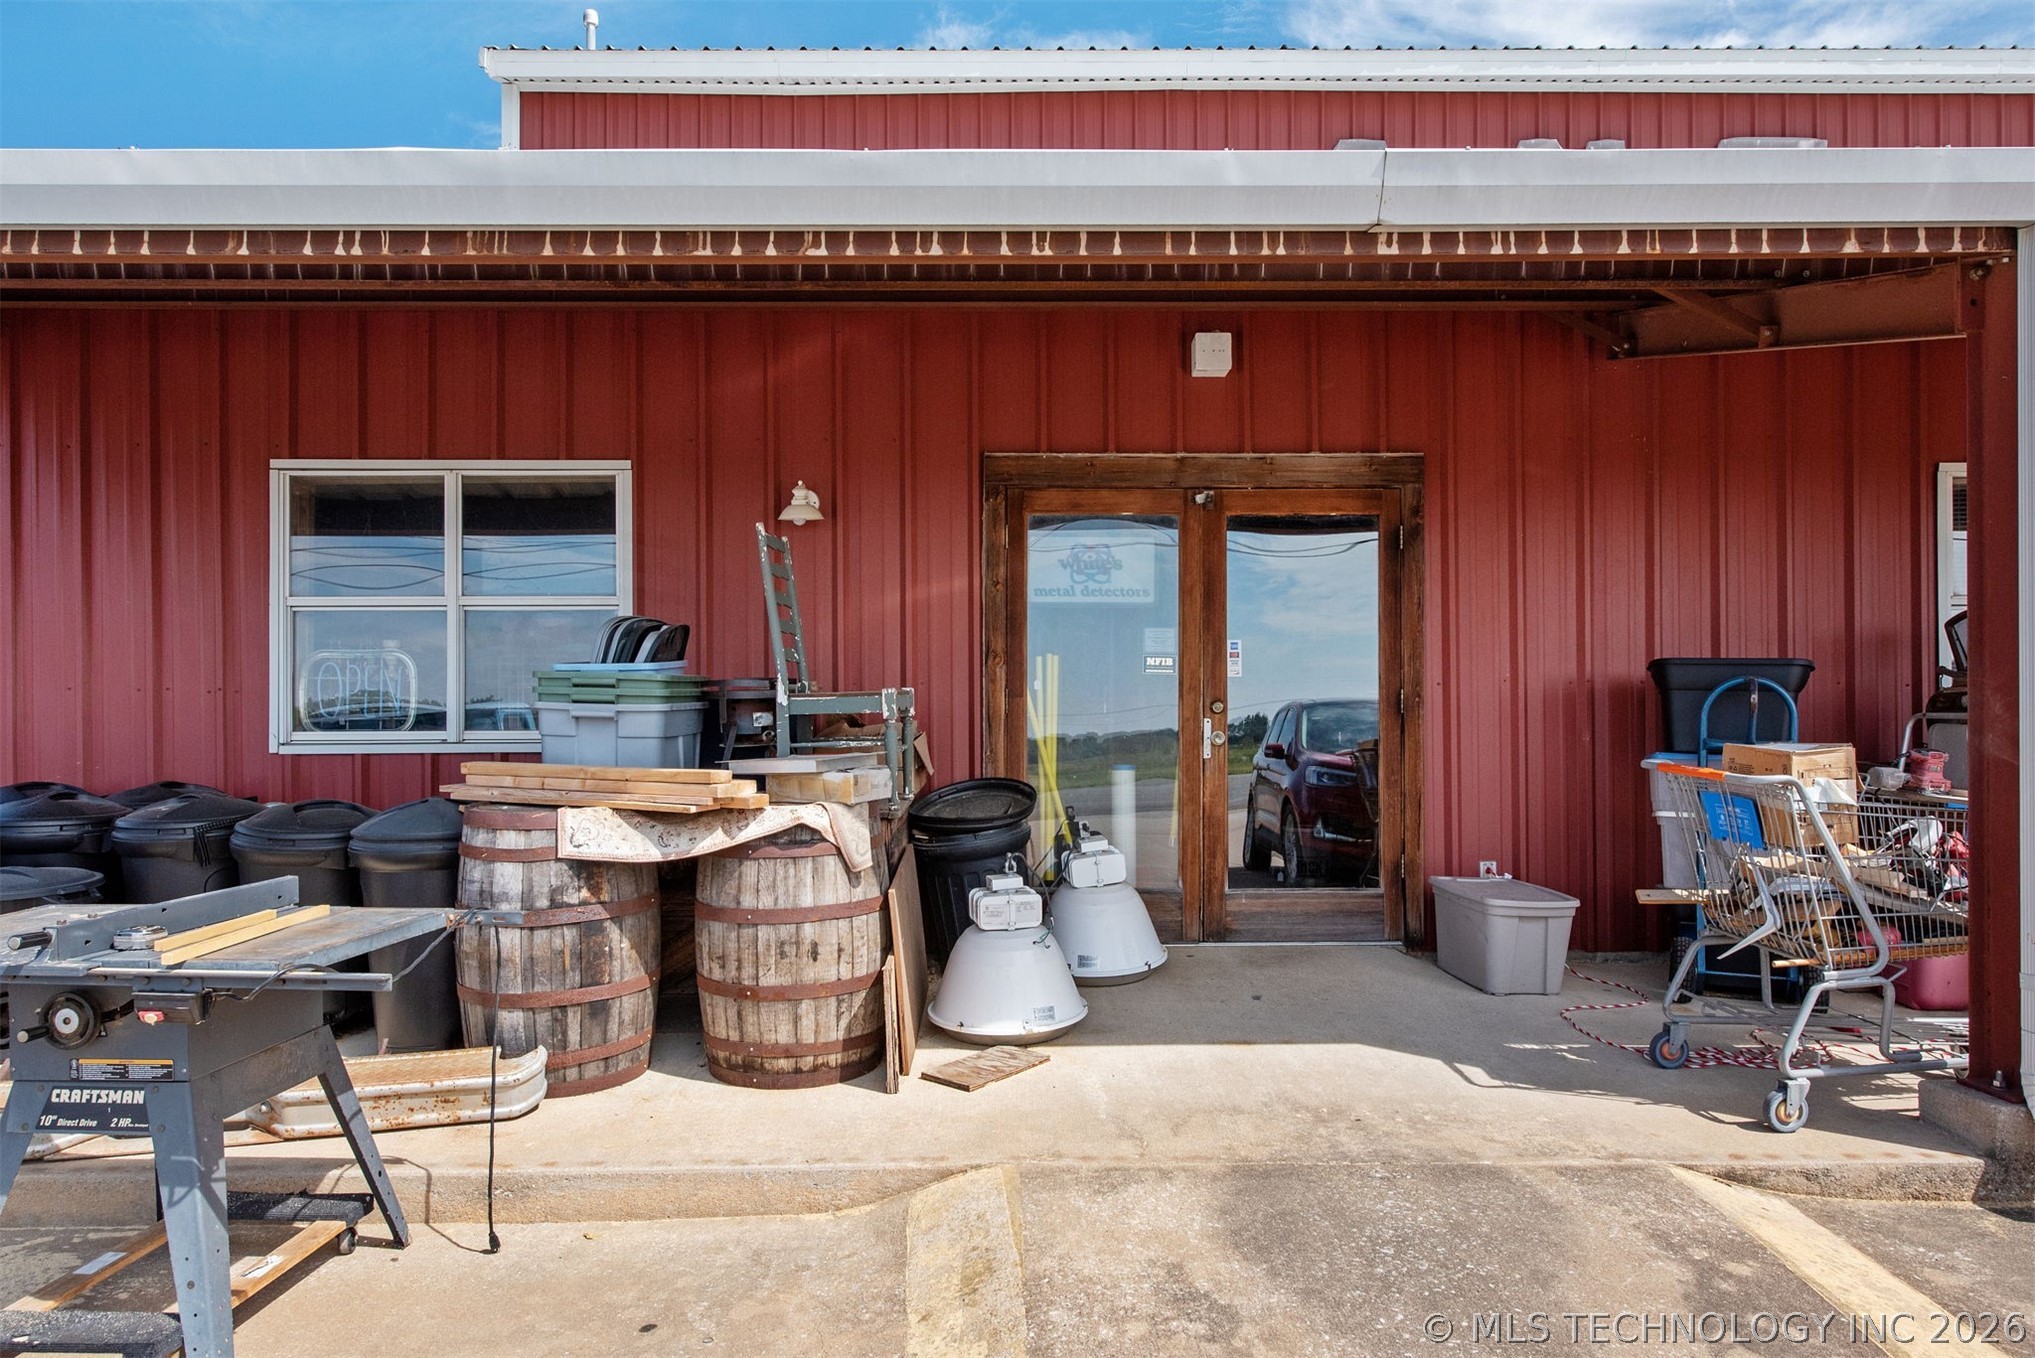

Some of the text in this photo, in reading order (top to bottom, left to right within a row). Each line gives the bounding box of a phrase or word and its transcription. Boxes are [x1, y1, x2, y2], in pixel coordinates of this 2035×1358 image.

[1033, 585, 1150, 597] metal detectors
[317, 659, 403, 718] OPEN
[51, 1088, 145, 1104] CRAFTSMAN
[57, 1118, 78, 1127] Direct
[79, 1118, 98, 1127] Drive
[110, 1118, 118, 1127] 2
